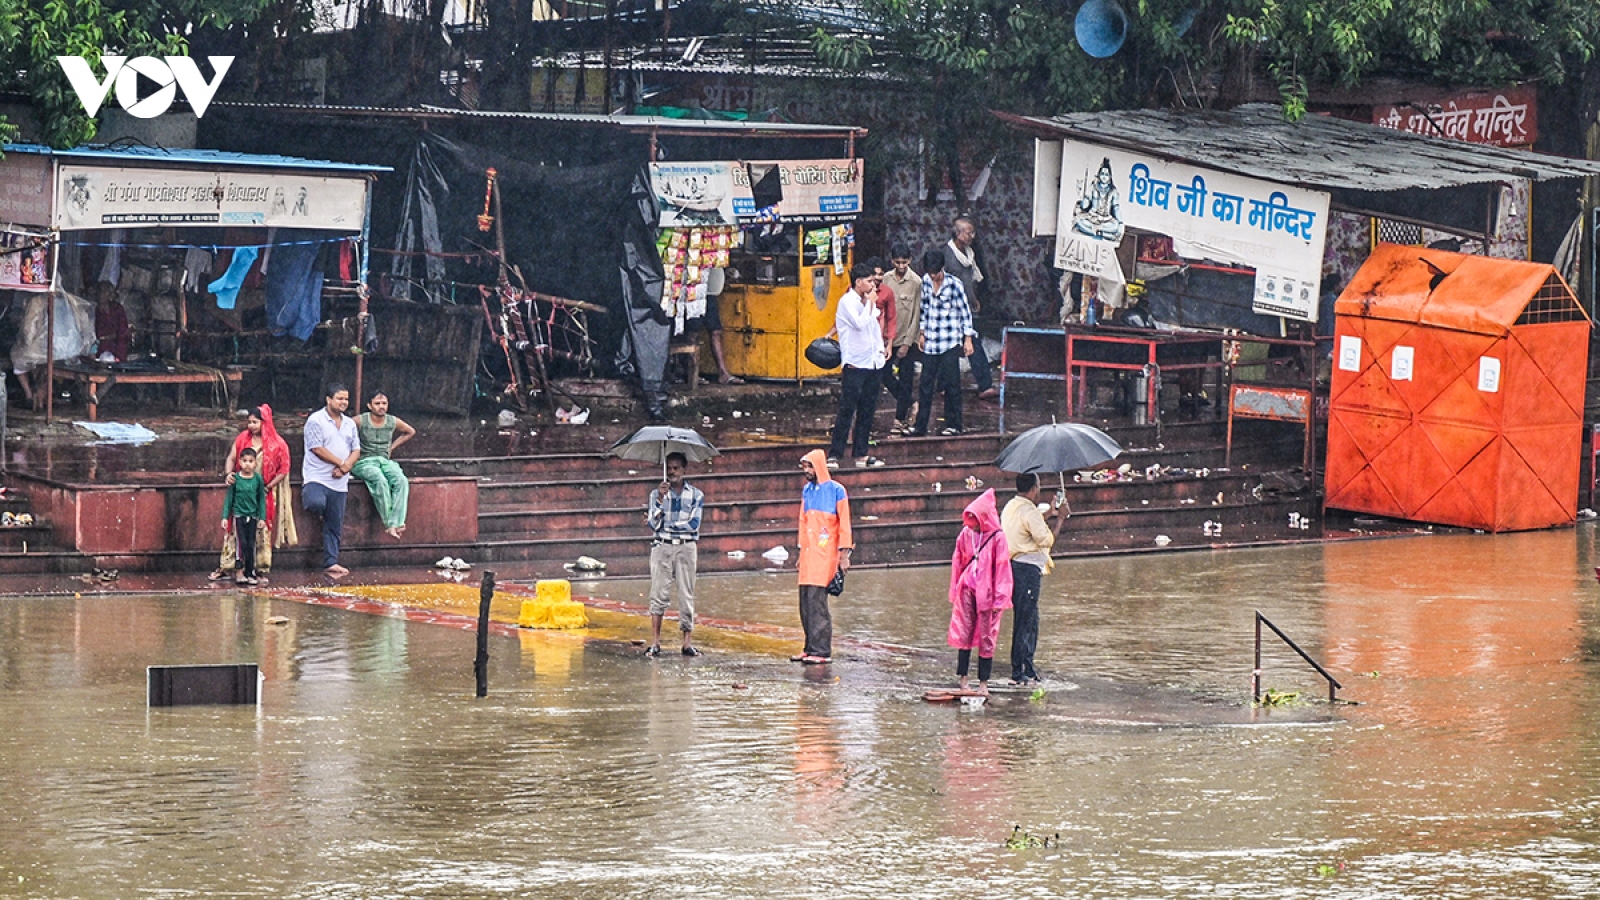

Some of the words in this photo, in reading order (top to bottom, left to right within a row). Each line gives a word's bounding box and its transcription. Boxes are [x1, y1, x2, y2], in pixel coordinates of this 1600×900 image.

[1474, 94, 1527, 143] मन्दिर
[1128, 163, 1172, 210] शिव
[1176, 175, 1208, 218] जी
[1212, 191, 1244, 225] का
[1249, 191, 1316, 240] मन्दिर
